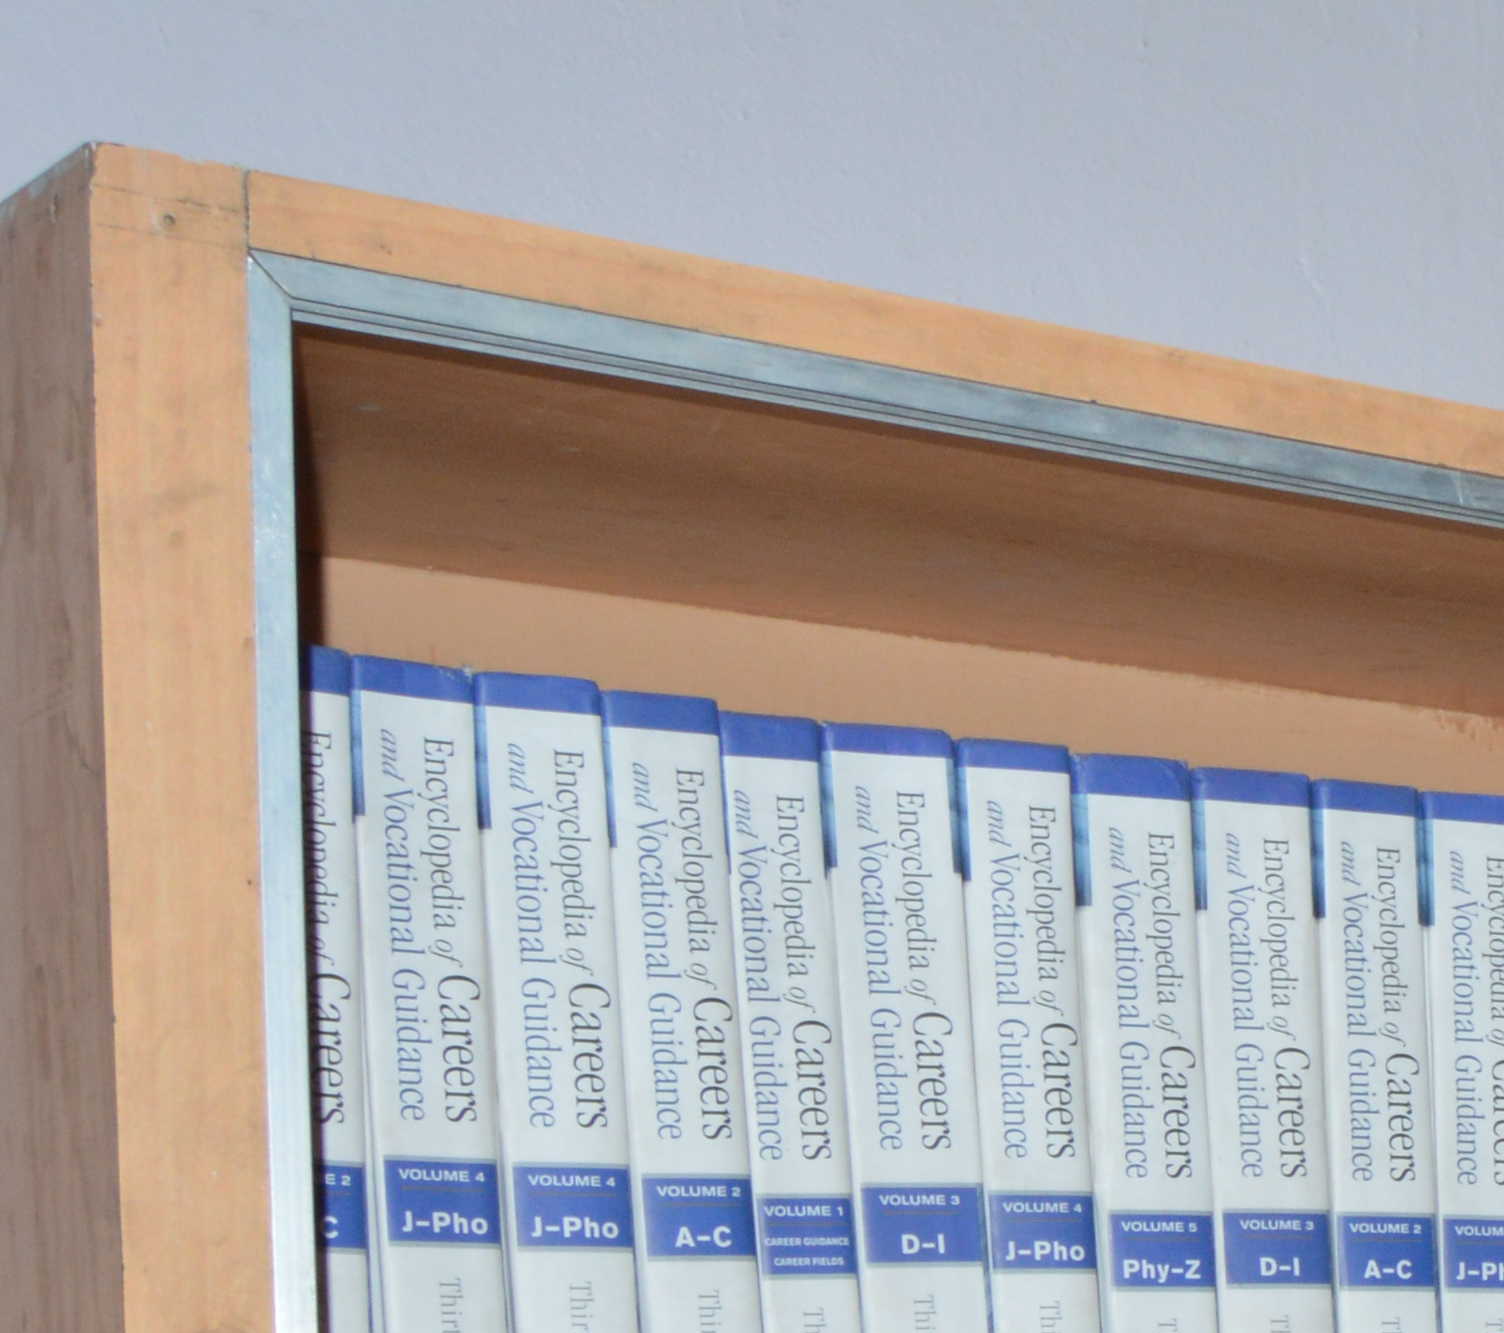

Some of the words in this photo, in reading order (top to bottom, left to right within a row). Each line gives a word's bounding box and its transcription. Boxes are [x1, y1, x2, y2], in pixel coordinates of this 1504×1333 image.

[380, 729, 404, 781] and
[417, 736, 464, 929] Encyclopedia
[1108, 827, 1132, 874] and
[383, 787, 426, 954] Vocational
[1145, 831, 1184, 1006] Encyclopedia
[431, 938, 464, 968] of
[1111, 879, 1150, 1030] Vocational
[392, 968, 432, 1121] Guidance
[1154, 1013, 1182, 1040] of
[437, 975, 480, 1123] Careers
[1118, 1042, 1154, 1179] Guidance
[1159, 1045, 1196, 1179] Careers
[399, 1168, 471, 1184] VOLUME
[475, 1171, 485, 1183] 4
[528, 1174, 601, 1188] VOLUME
[605, 1177, 616, 1187] 4
[878, 1194, 946, 1207] VOLUME
[950, 1194, 961, 1206] 3
[402, 1210, 489, 1236] J-Pho
[531, 1216, 620, 1239] J-Pho
[1120, 1220, 1186, 1234] VOLUME
[1189, 1222, 1198, 1233] 5
[901, 1233, 945, 1255] D-I
[1123, 1260, 1202, 1283] Phy-Z
